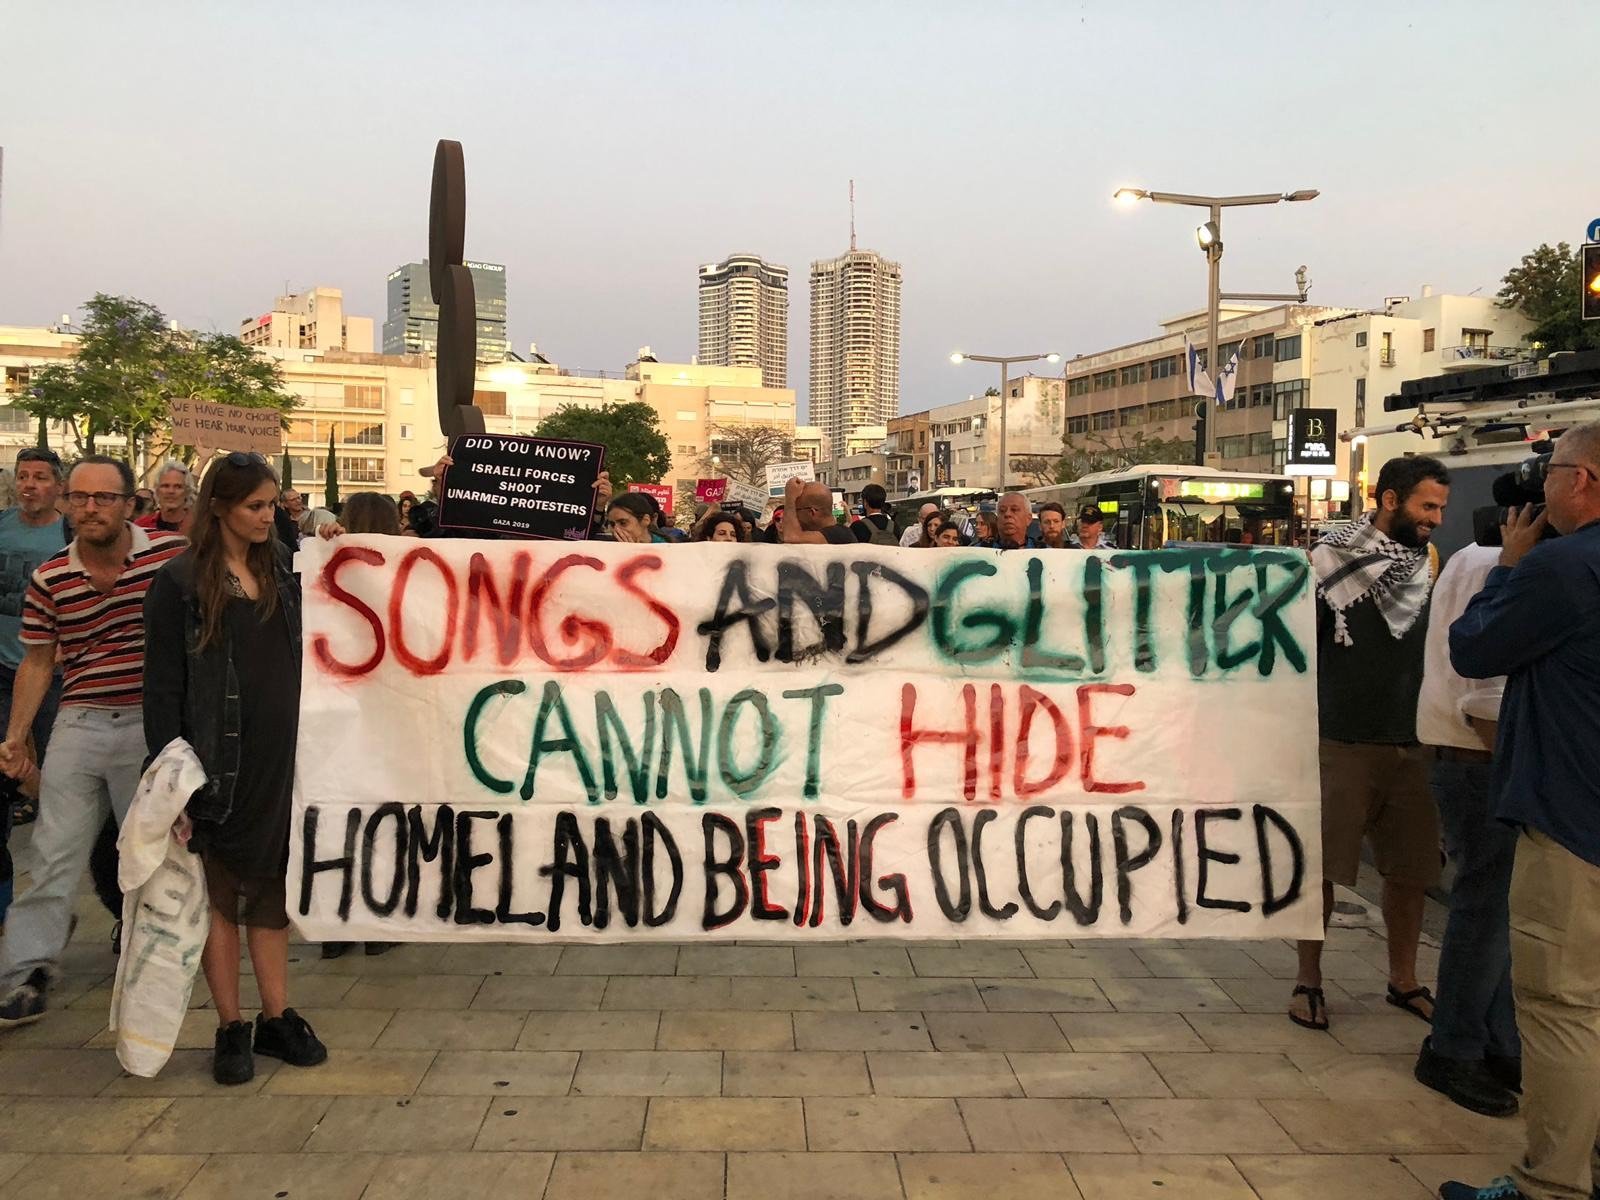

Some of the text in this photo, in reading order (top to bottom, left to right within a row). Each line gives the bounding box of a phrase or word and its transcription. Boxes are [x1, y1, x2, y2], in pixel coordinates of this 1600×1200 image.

[172, 402, 279, 421] WE HAVE NO CHOICE
[172, 417, 279, 437] WE HEAR YOUR VOICE
[465, 438, 591, 461] DID YOU KNOW?
[471, 463, 576, 484] ISRAELI FORCES
[499, 481, 542, 494] SHOOT
[447, 488, 588, 516] UNARMED PROTESTERS
[492, 518, 530, 529] GAZA 2019
[312, 545, 1309, 678] SONGS AND GLITTER
[463, 678, 1147, 806] CANNOT HIDE
[299, 801, 684, 932] HOMELAND
[703, 805, 913, 931] BEING
[927, 803, 1305, 926] OCCUPIED
